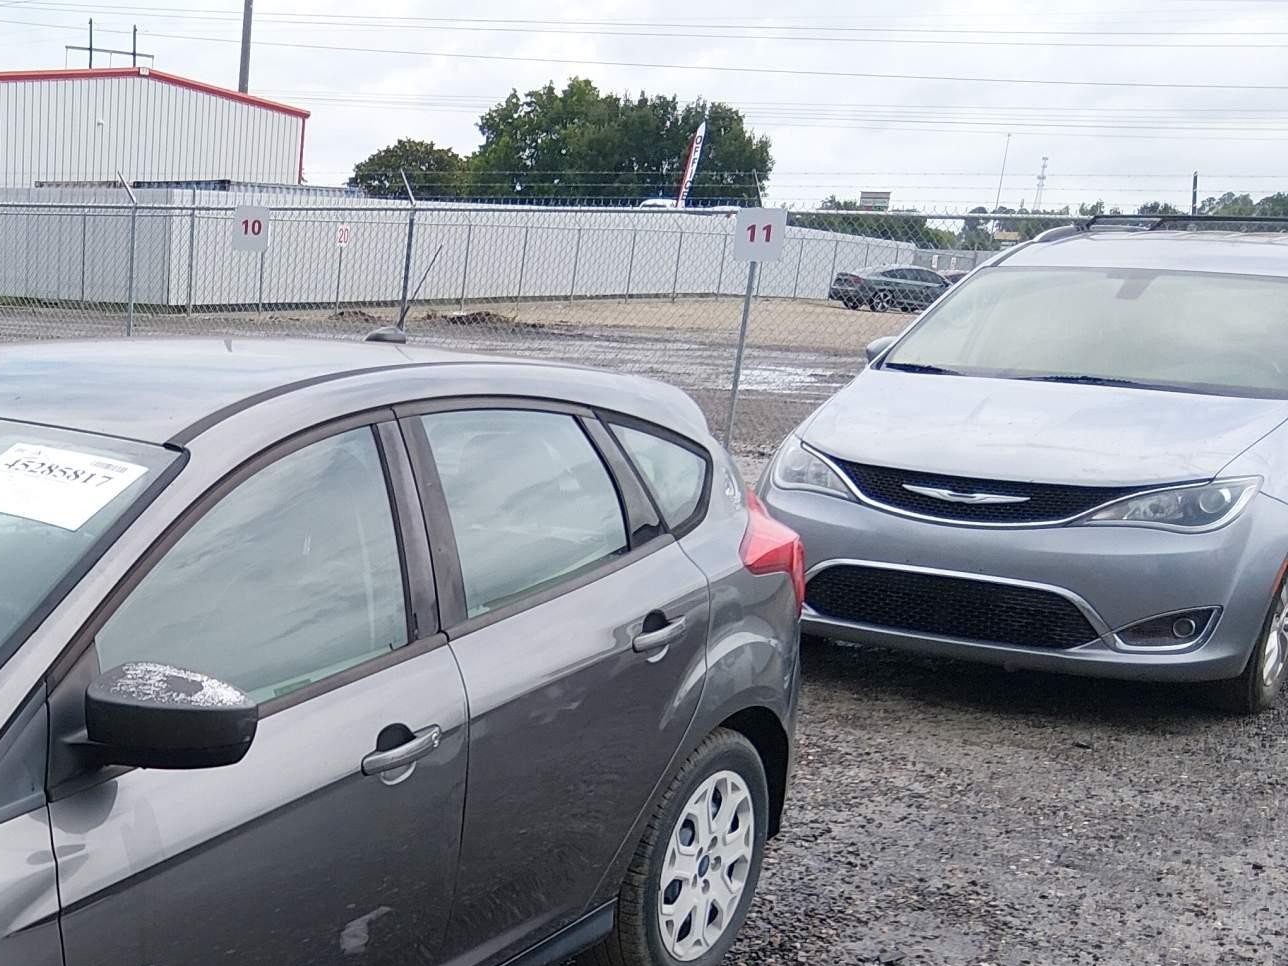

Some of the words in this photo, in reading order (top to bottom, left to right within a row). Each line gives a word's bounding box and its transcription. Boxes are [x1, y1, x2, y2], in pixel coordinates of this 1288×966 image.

[682, 135, 703, 201] OFFICE
[242, 219, 262, 236] 10
[338, 228, 349, 244] 20
[747, 224, 772, 243] 11
[4, 459, 113, 487] 45285817
